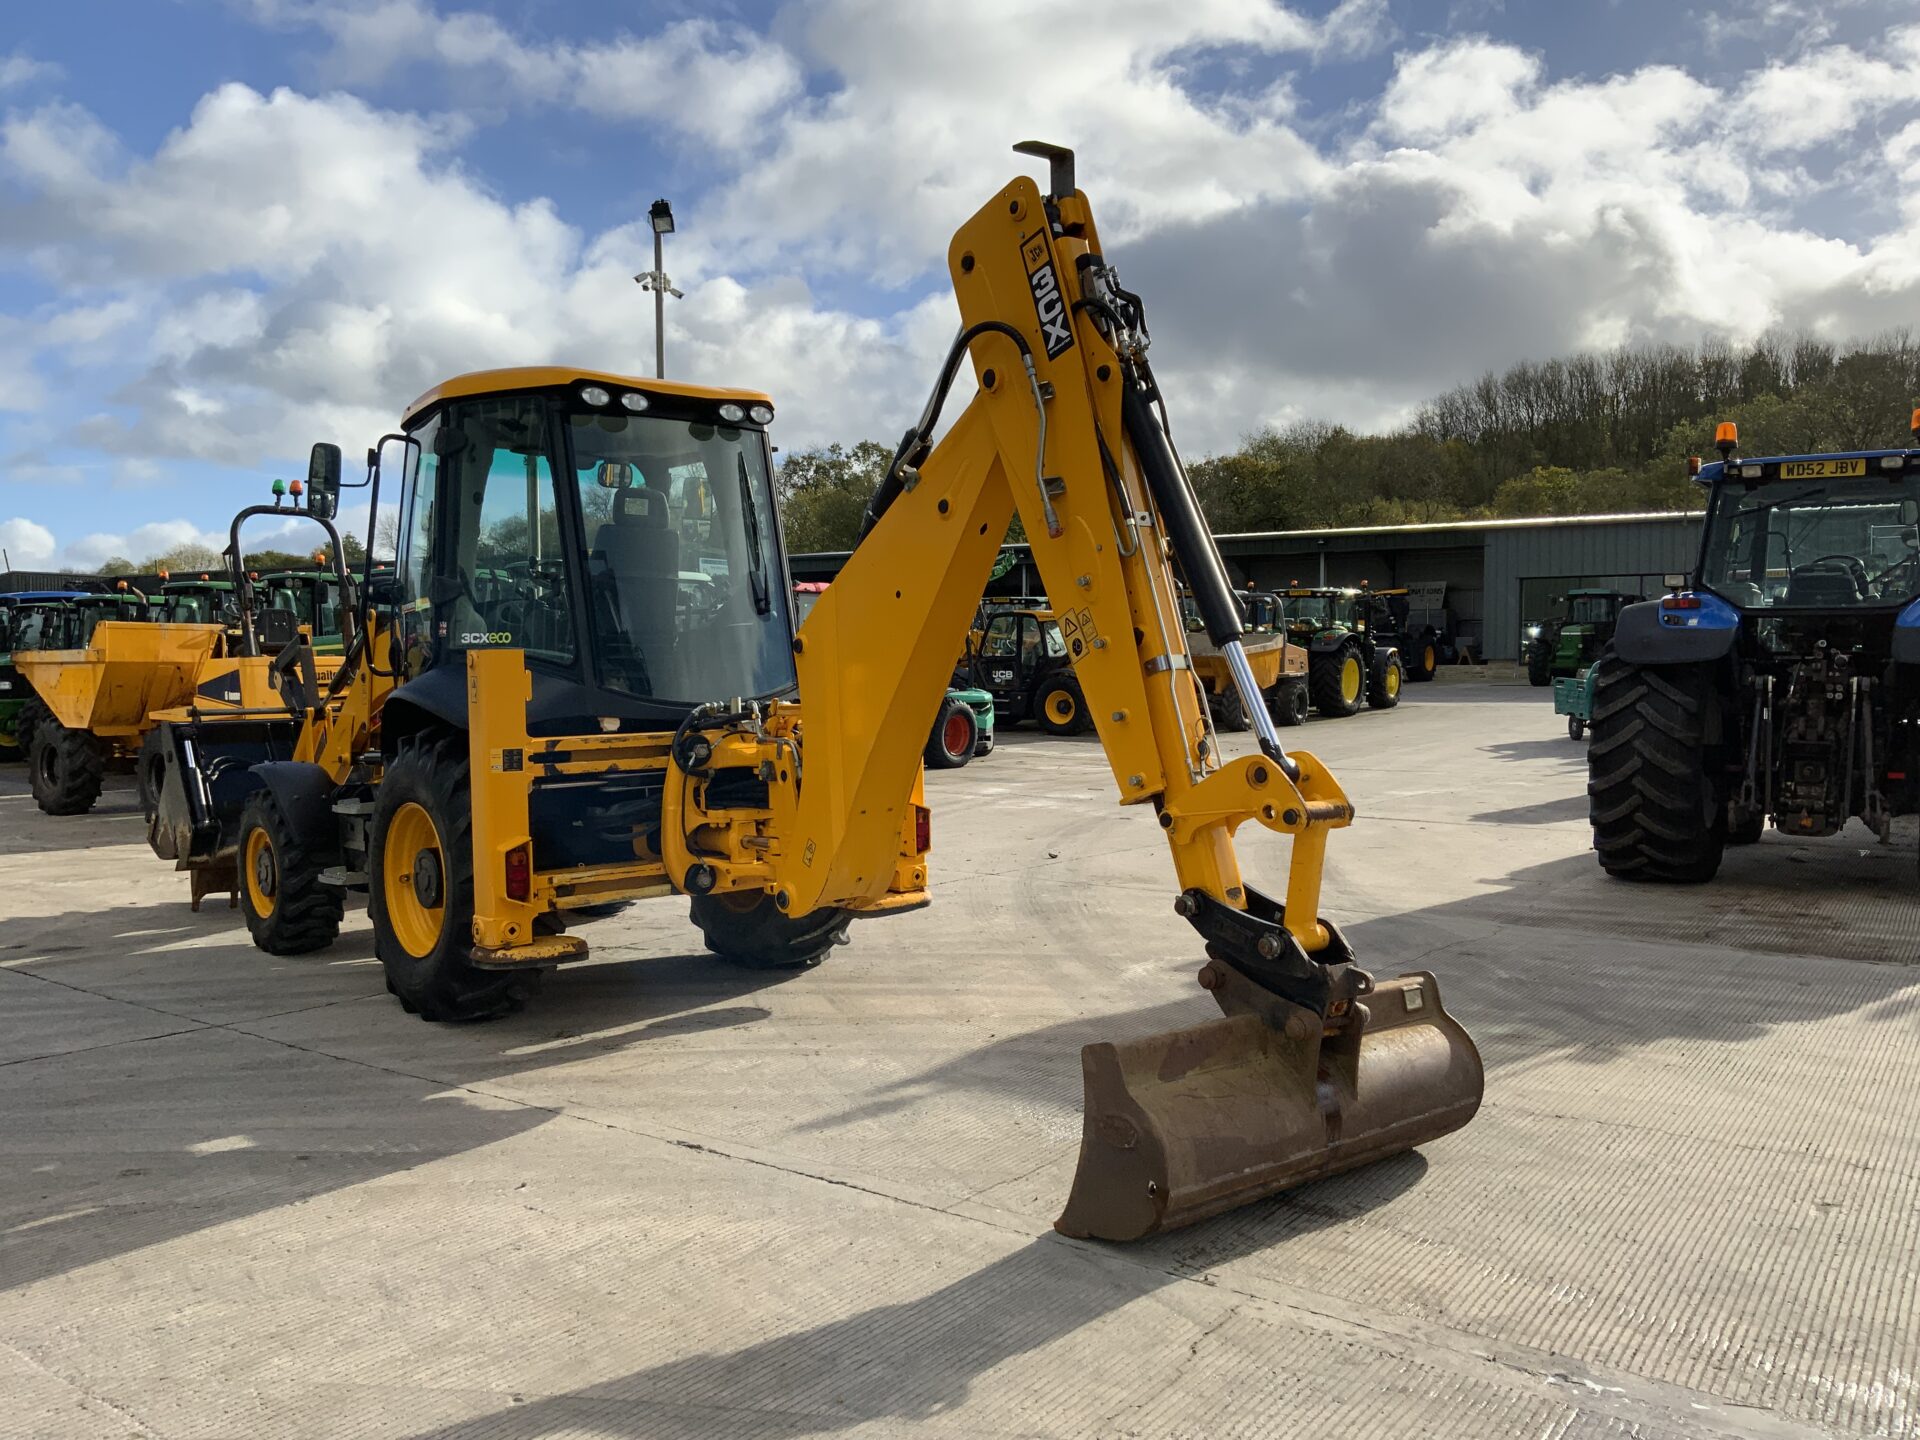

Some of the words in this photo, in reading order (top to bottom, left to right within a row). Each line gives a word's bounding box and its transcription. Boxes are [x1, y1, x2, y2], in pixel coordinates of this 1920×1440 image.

[1032, 265, 1071, 350] 3CX
[1786, 463, 1824, 476] WD52
[1830, 461, 1858, 475] JBV
